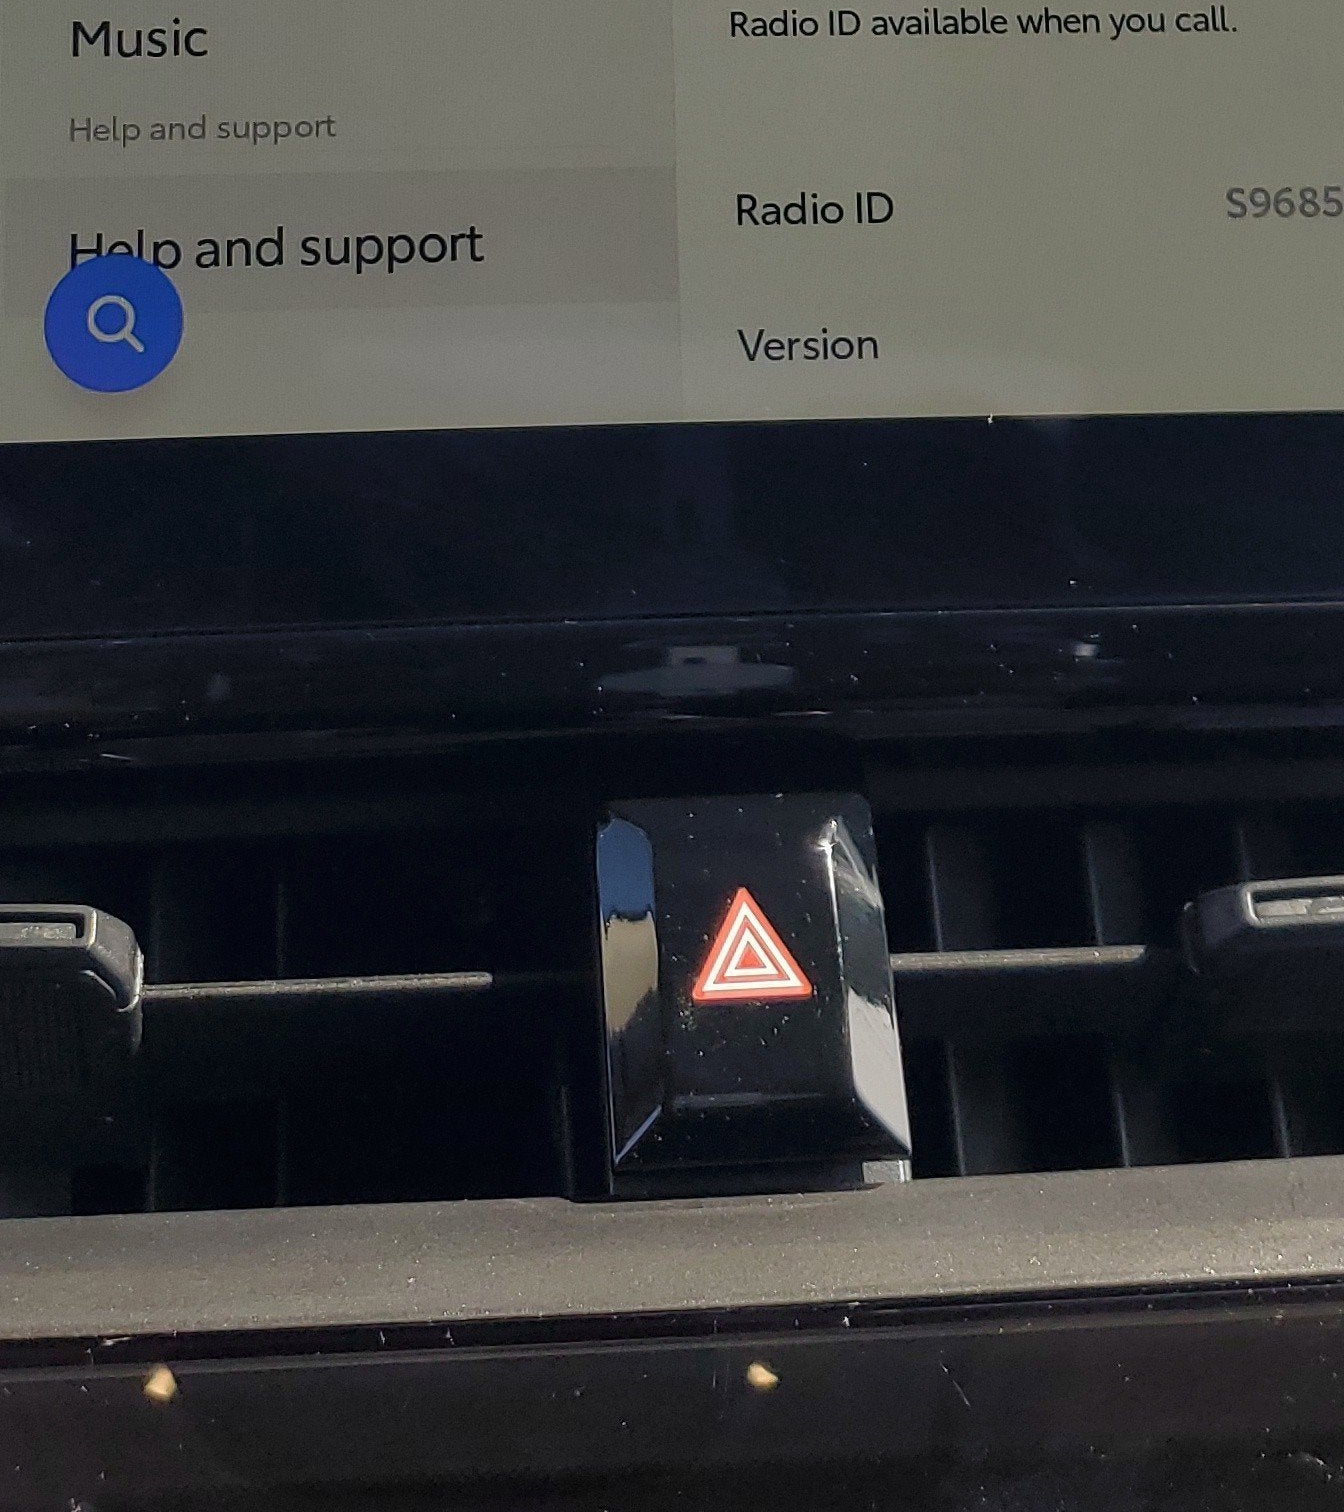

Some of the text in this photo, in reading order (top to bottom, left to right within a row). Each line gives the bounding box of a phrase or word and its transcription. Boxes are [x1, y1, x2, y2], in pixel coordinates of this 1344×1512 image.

[73, 18, 207, 57] Music
[731, 5, 1237, 40] Radio ID available when you call.
[70, 114, 336, 148] Help and support
[737, 192, 893, 225] Radio ID
[196, 226, 283, 268] and
[301, 226, 484, 274] support
[737, 328, 878, 361] Version
